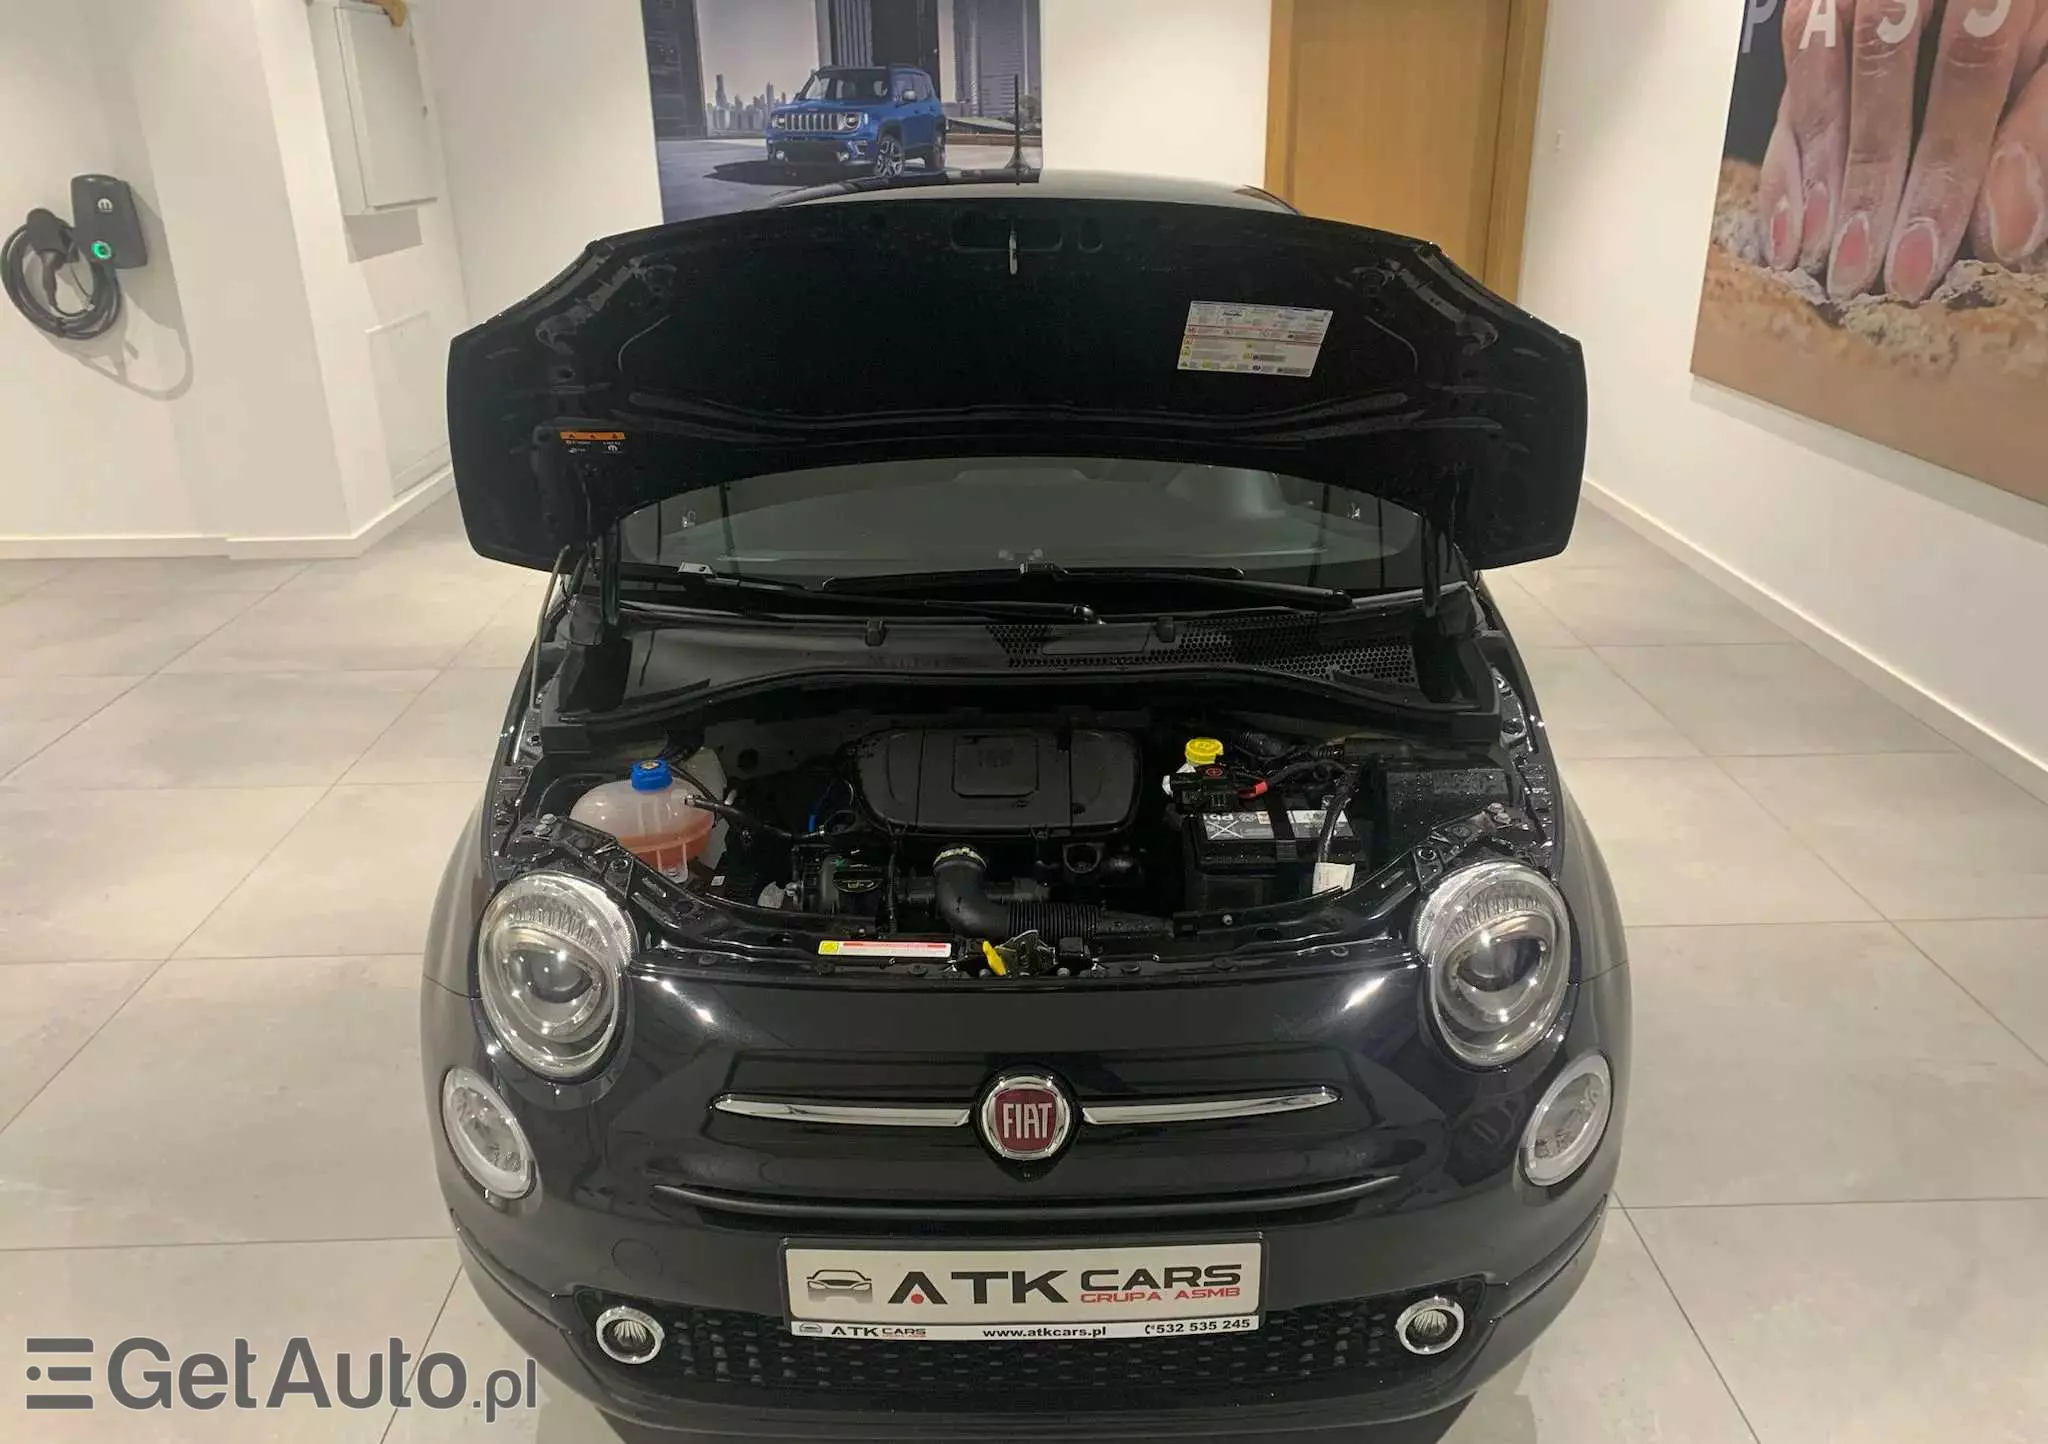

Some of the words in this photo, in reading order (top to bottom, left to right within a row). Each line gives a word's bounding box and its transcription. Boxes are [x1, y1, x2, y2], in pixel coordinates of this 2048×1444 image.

[1003, 1103, 1053, 1139] FIAT
[887, 1270, 1069, 1304] ATK
[1081, 1264, 1242, 1292] CARS
[1081, 1291, 1162, 1304] GRUPA
[1174, 1287, 1241, 1300] ASMB
[831, 1326, 879, 1337] ATK
[881, 1327, 927, 1335] CARS
[982, 1326, 1107, 1338] www.atkcars.pl
[1156, 1323, 1184, 1333] 532
[1190, 1321, 1217, 1331] 535
[1222, 1319, 1250, 1329] 245
